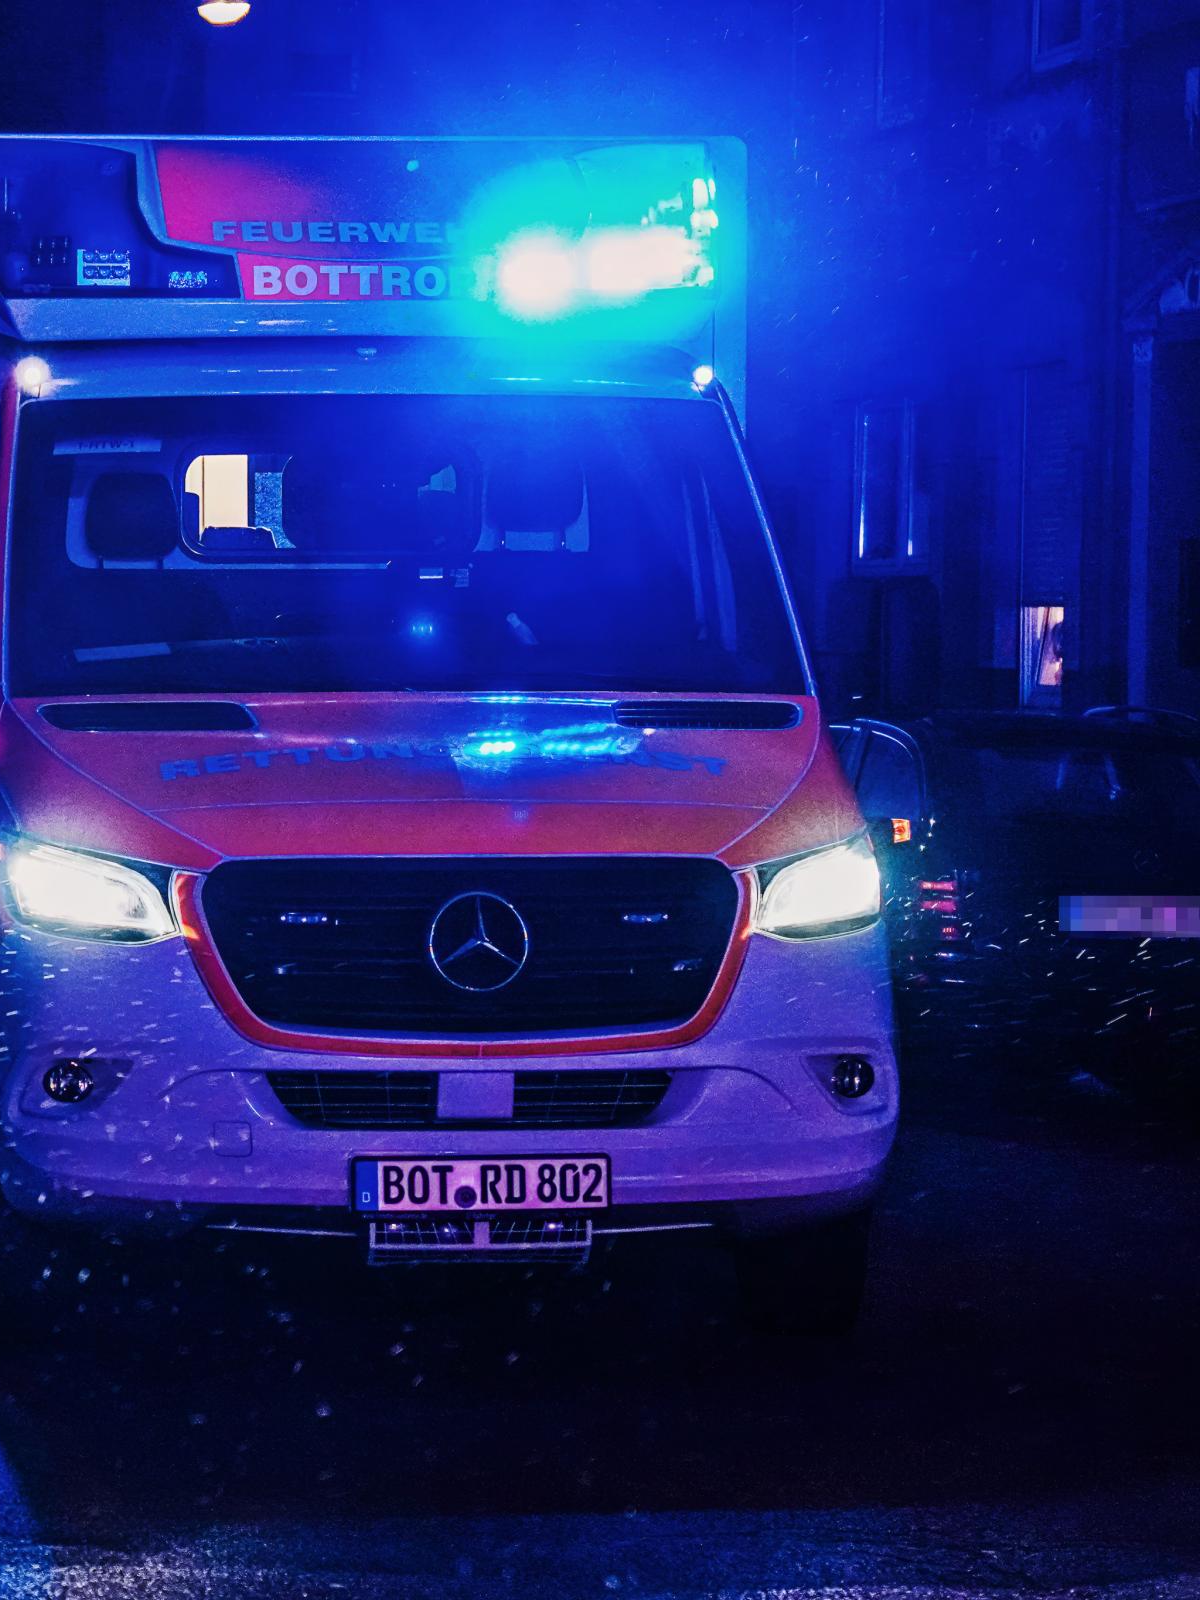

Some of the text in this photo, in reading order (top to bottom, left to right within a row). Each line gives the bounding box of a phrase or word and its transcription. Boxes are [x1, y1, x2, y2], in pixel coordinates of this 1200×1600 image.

[211, 220, 460, 243] FEUERWE
[252, 264, 470, 297] BOTTRO
[362, 1162, 604, 1205] D BOT RD 802
